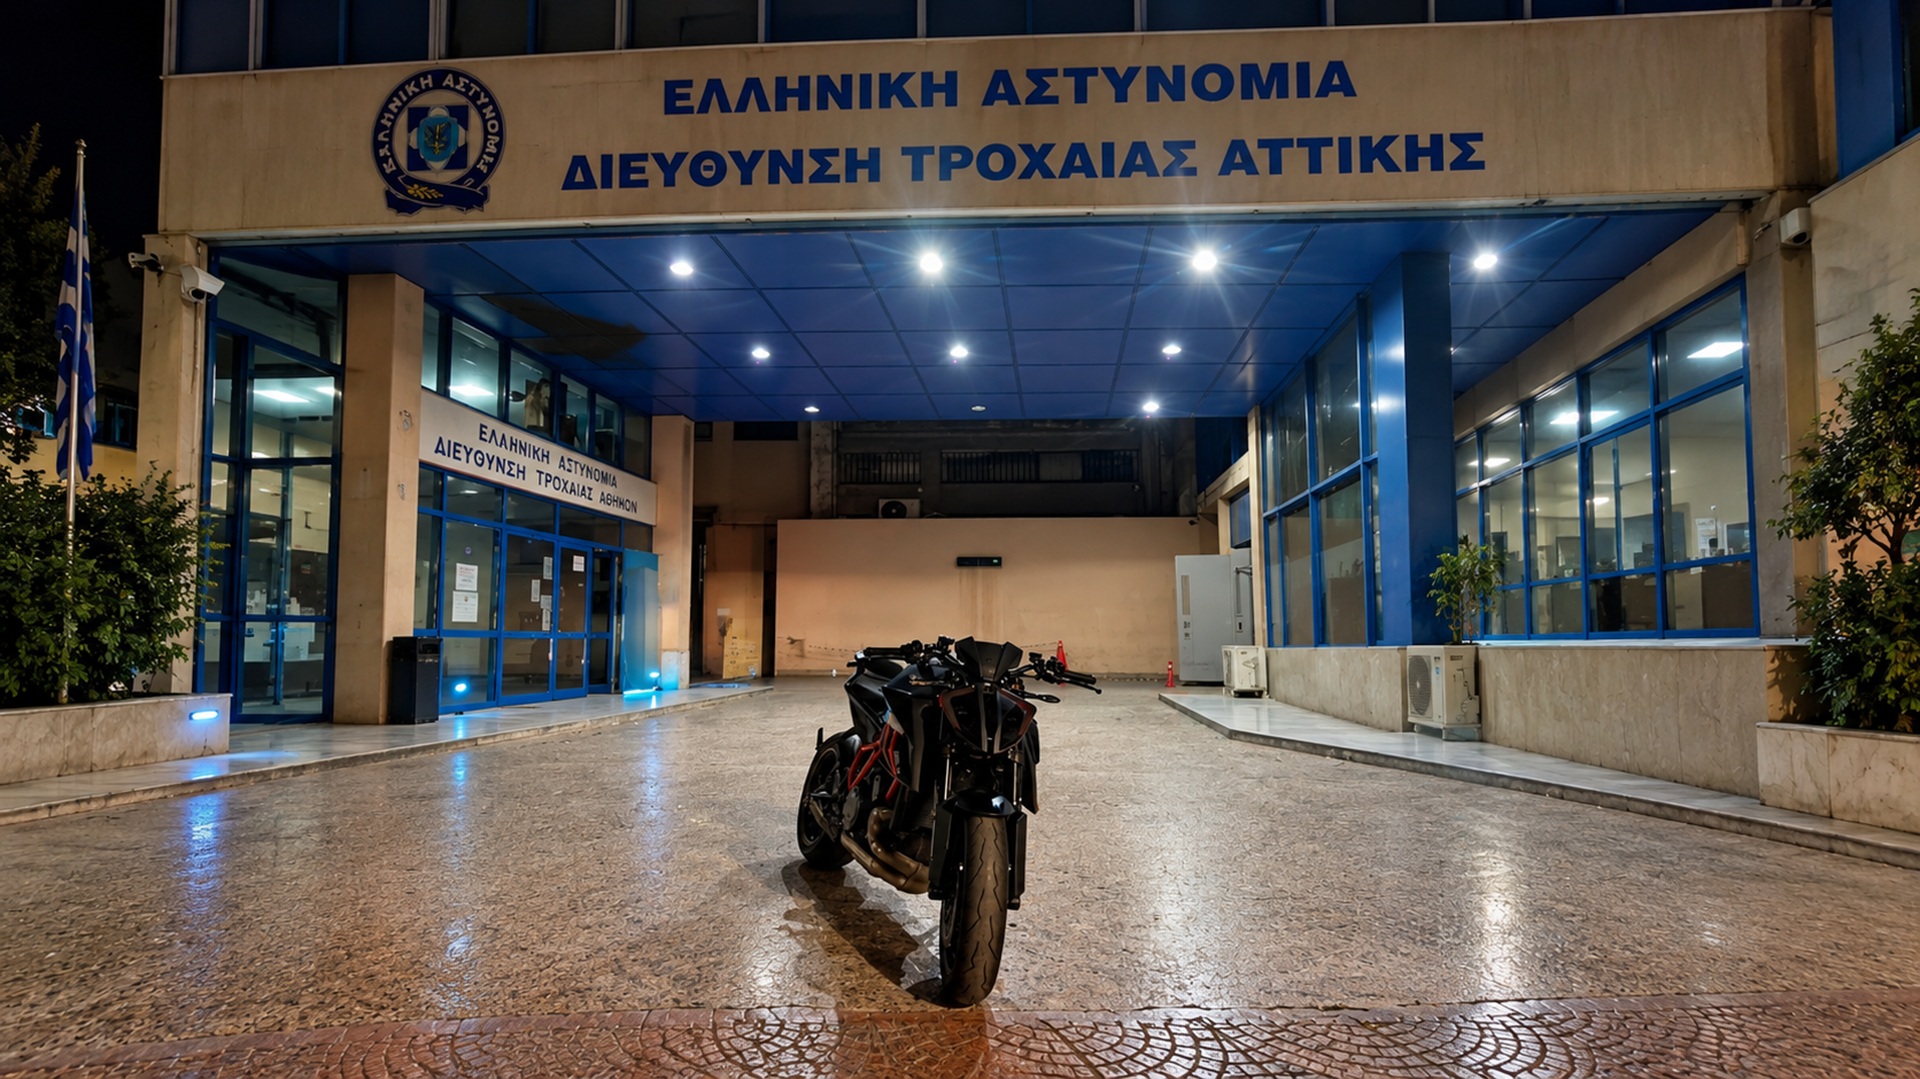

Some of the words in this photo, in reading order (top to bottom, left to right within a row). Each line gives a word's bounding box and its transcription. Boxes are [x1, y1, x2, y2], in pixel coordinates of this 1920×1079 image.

[663, 70, 958, 115] ΕΛΛΗΝΙΚΗ
[981, 60, 1357, 107] ΑΣΤΥΝΟΜΙΑ
[561, 147, 881, 191] ΔΙΕΥΘΥΝΣΗ
[901, 140, 1198, 183] ΤΡΟΧΑΙΑΣ
[1218, 132, 1486, 177] ΑΤΤΙΚΗΣ
[434, 436, 526, 481] ΔΙΕΥΘΥΝΣΗ
[536, 470, 594, 502] ΤΡΟΧΑΙΑΣ
[558, 455, 617, 488] ΑΣΤΥΝΟΜΙΑ
